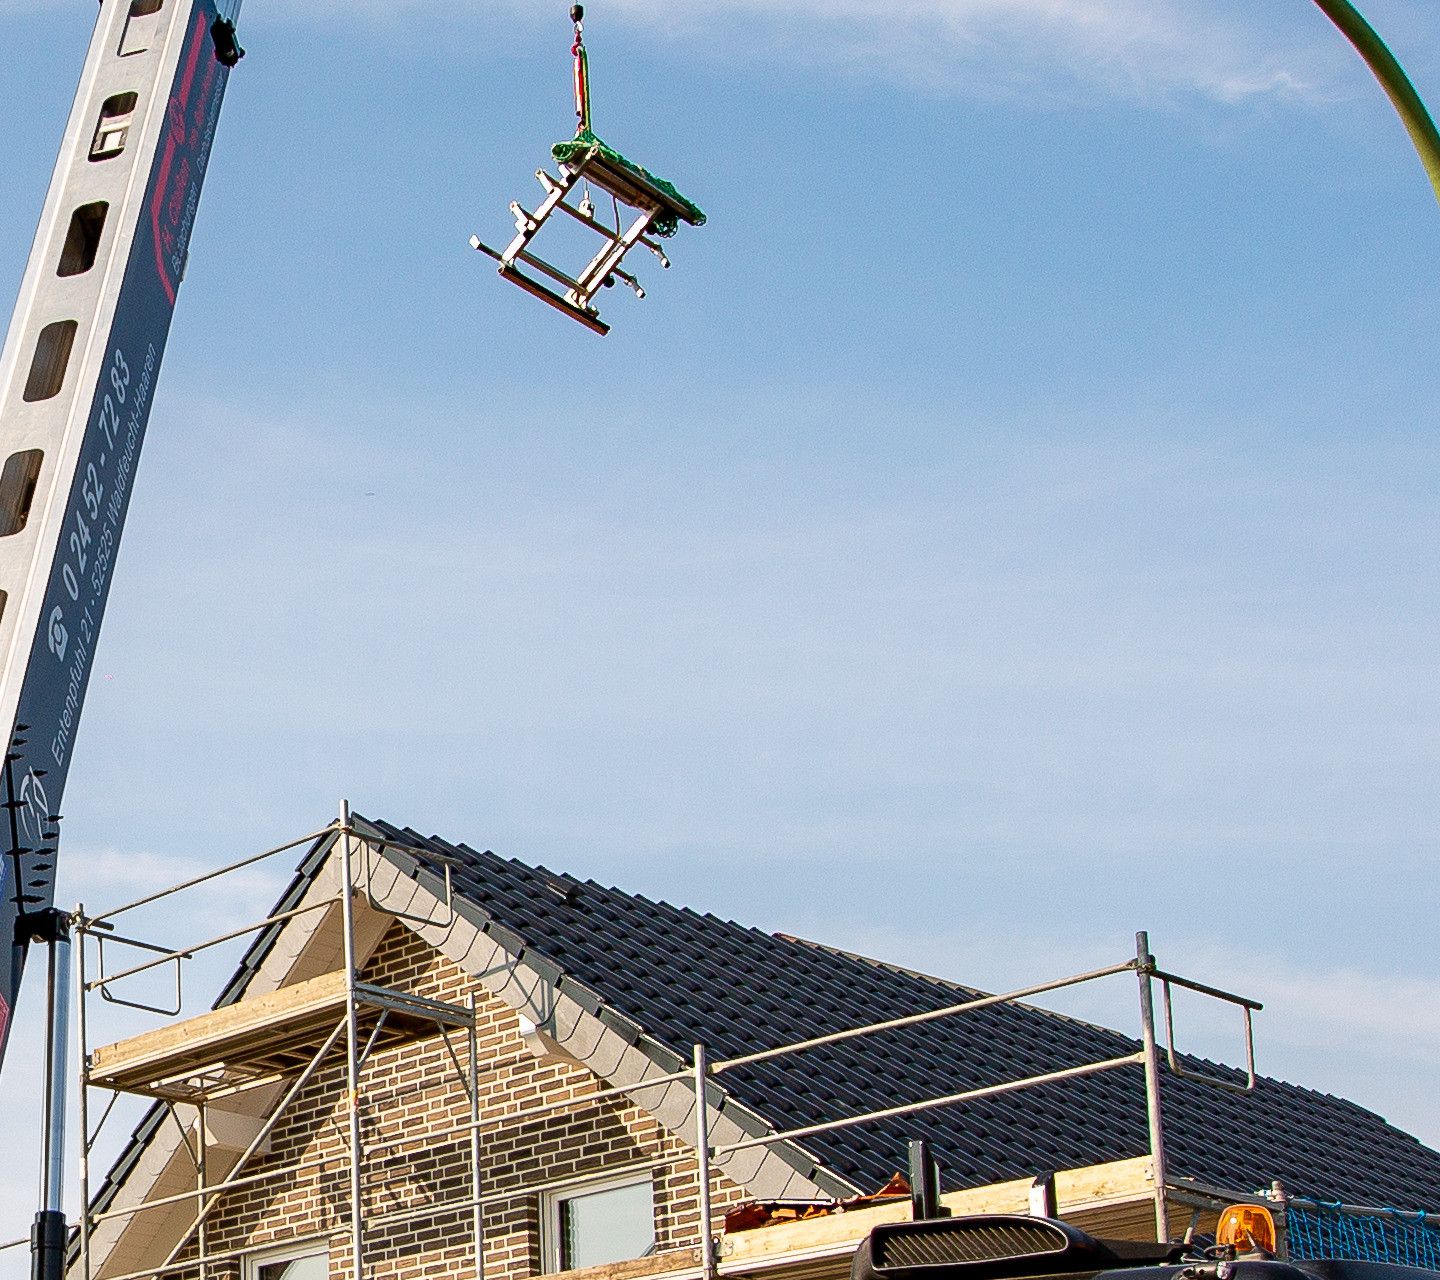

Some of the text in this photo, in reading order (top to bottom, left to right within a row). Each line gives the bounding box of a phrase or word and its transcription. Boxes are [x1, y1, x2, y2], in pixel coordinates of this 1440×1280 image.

[110, 348, 131, 404] 83
[98, 393, 120, 451] 72
[82, 461, 105, 521] 52
[51, 342, 158, 767] Entenpfuhl 21 52525 Waldfeucht-Haaren
[70, 509, 92, 574] 24
[63, 562, 79, 601] 0
